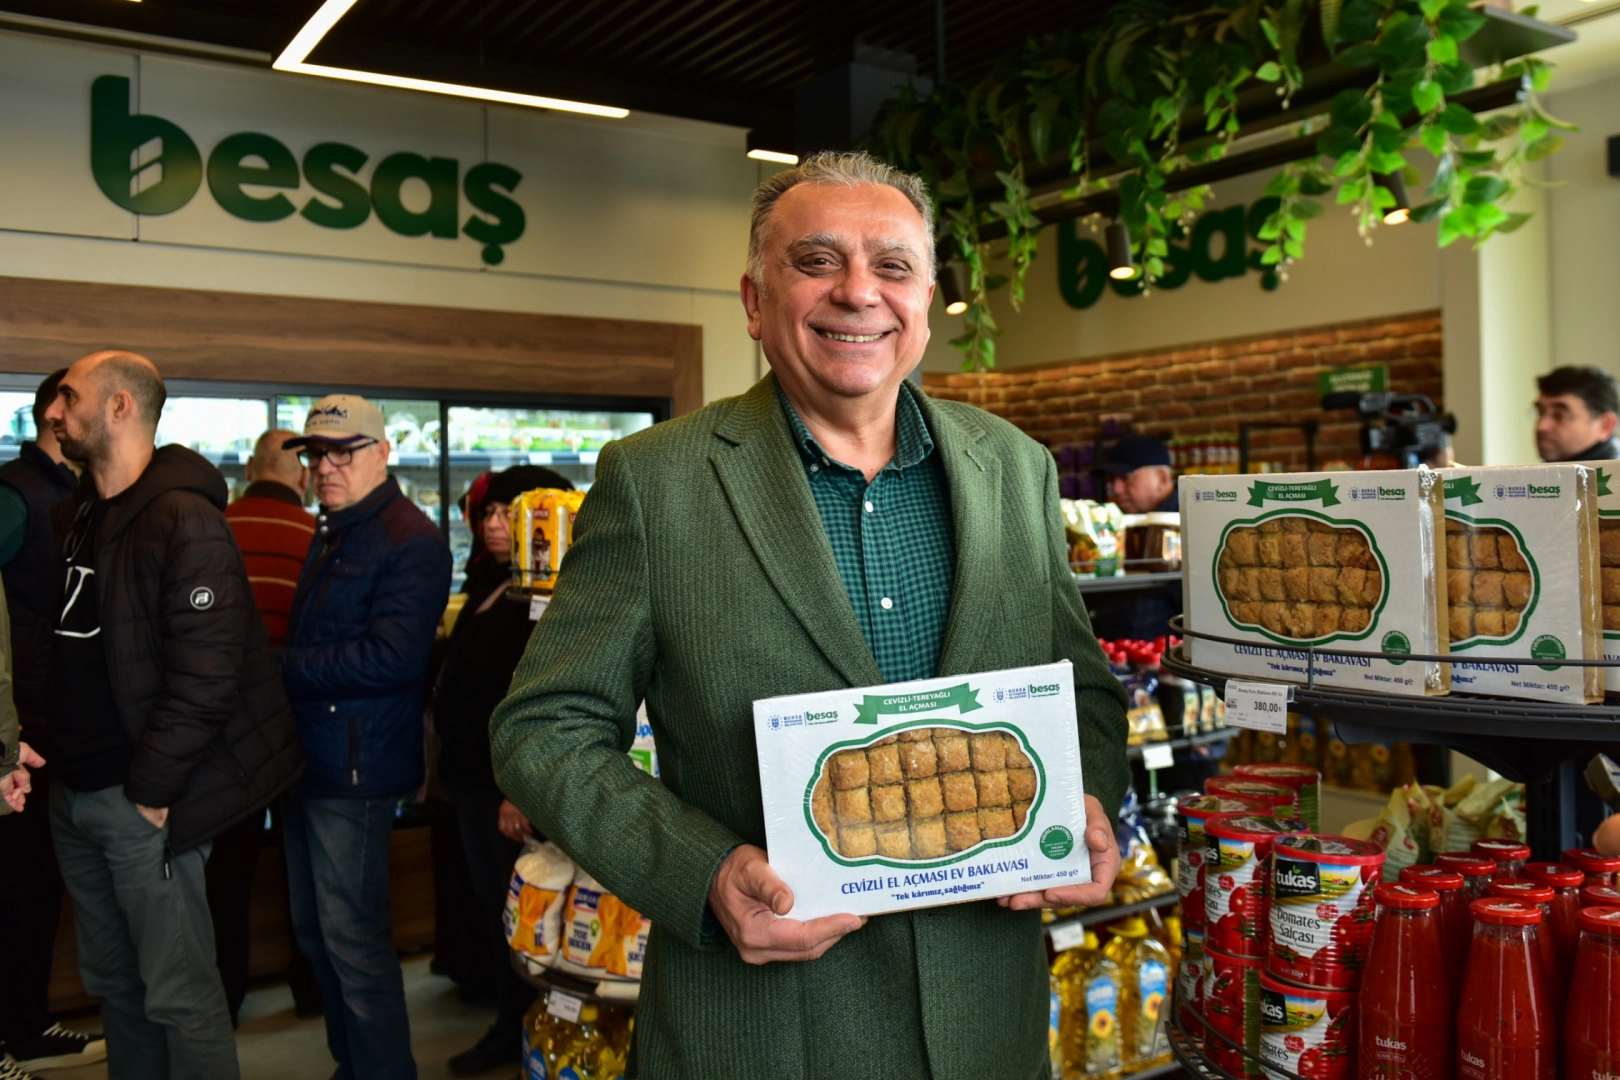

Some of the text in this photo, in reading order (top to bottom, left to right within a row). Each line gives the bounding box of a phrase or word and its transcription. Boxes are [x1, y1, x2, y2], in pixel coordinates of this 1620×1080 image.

[91, 74, 526, 265] besaş
[1380, 486, 1405, 497] besaş
[1530, 484, 1560, 494] besaş
[1029, 683, 1060, 694] besaş
[883, 691, 951, 705] CEVİZLİ-TEREYAĞLI
[909, 702, 937, 711] AÇMASI
[806, 711, 838, 721] besaş
[841, 858, 1029, 895] CEVİZLİ EL AÇMASI EV BAKLAVASI
[1276, 869, 1317, 889] tukaş
[1276, 906, 1321, 930] Domates
[1279, 923, 1314, 944] Salçası
